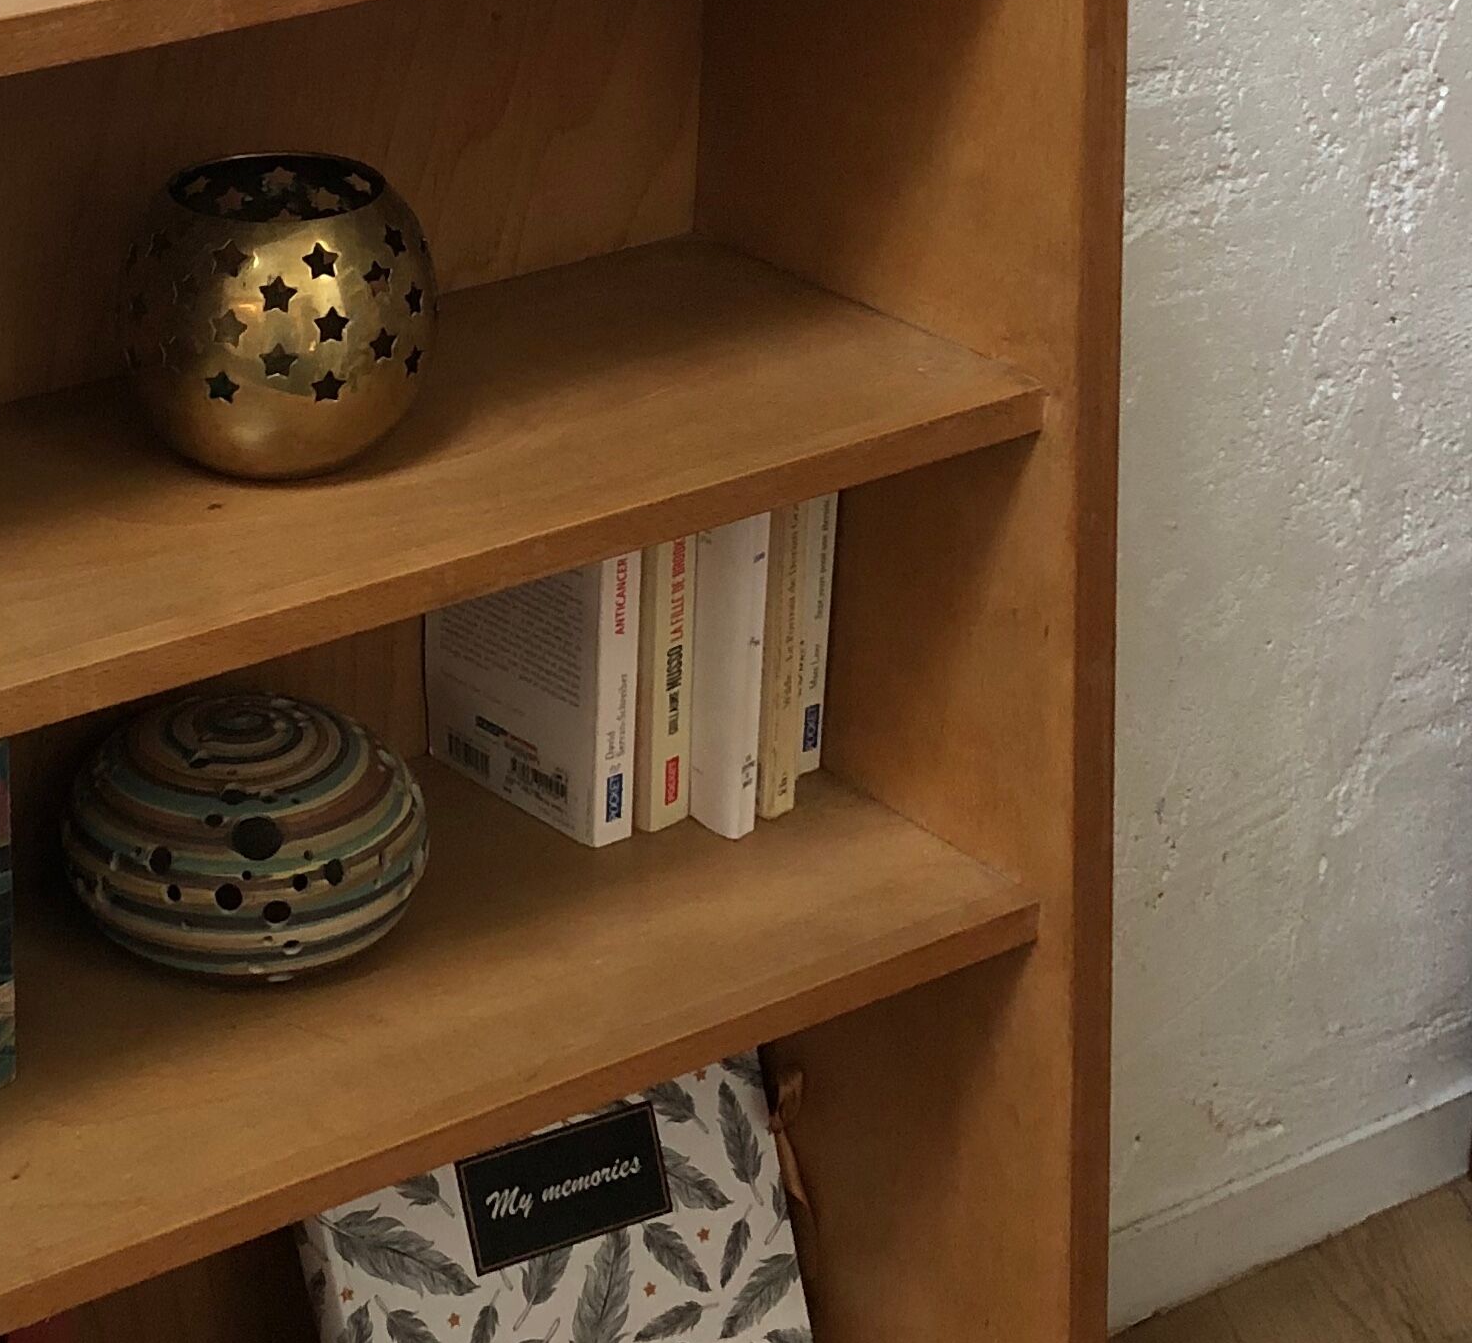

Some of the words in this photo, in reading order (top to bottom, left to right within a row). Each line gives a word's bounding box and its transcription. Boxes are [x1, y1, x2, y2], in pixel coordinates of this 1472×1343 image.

[614, 558, 628, 635] ANTICANCER
[671, 594, 684, 626] FILLE
[666, 644, 683, 691] MUSSO
[485, 1186, 534, 1220] My
[541, 1156, 642, 1203] memories
